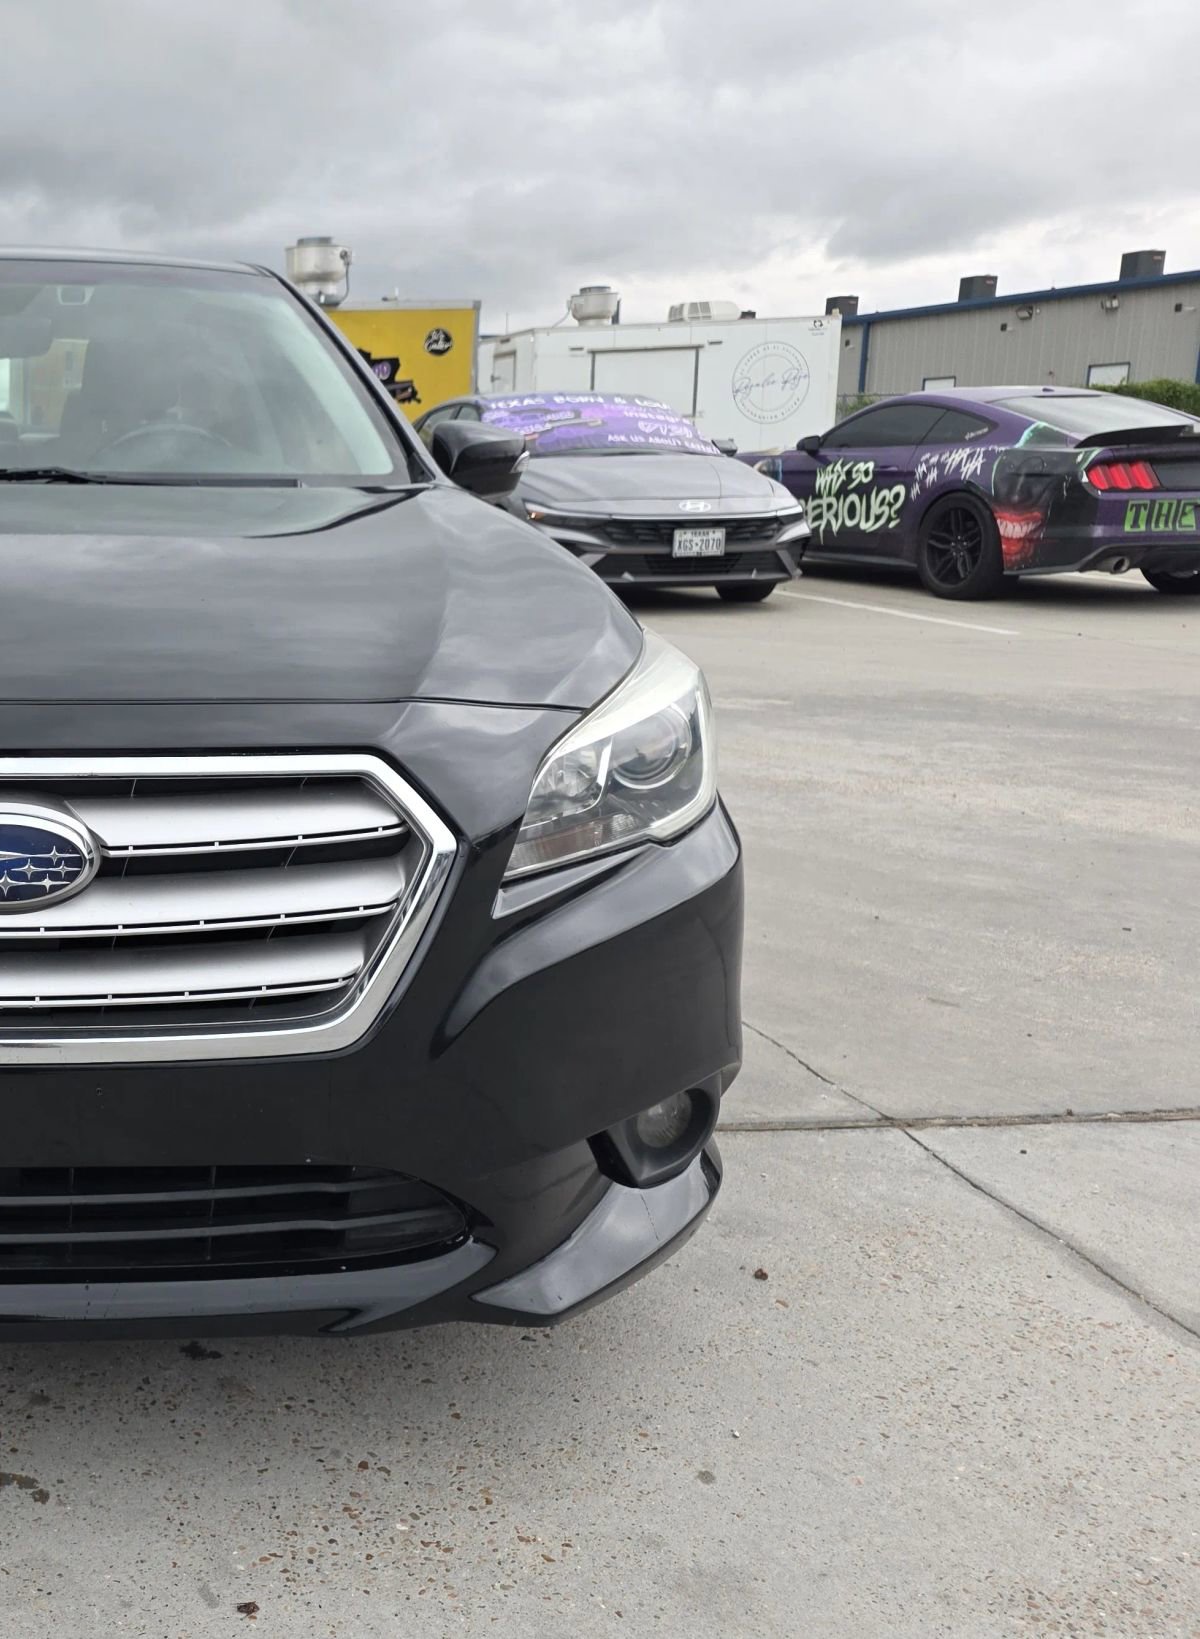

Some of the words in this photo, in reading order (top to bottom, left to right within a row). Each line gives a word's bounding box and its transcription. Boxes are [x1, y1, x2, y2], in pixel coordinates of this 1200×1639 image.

[815, 457, 855, 498] WHY
[847, 461, 875, 491] SO
[1125, 500, 1197, 531] THE
